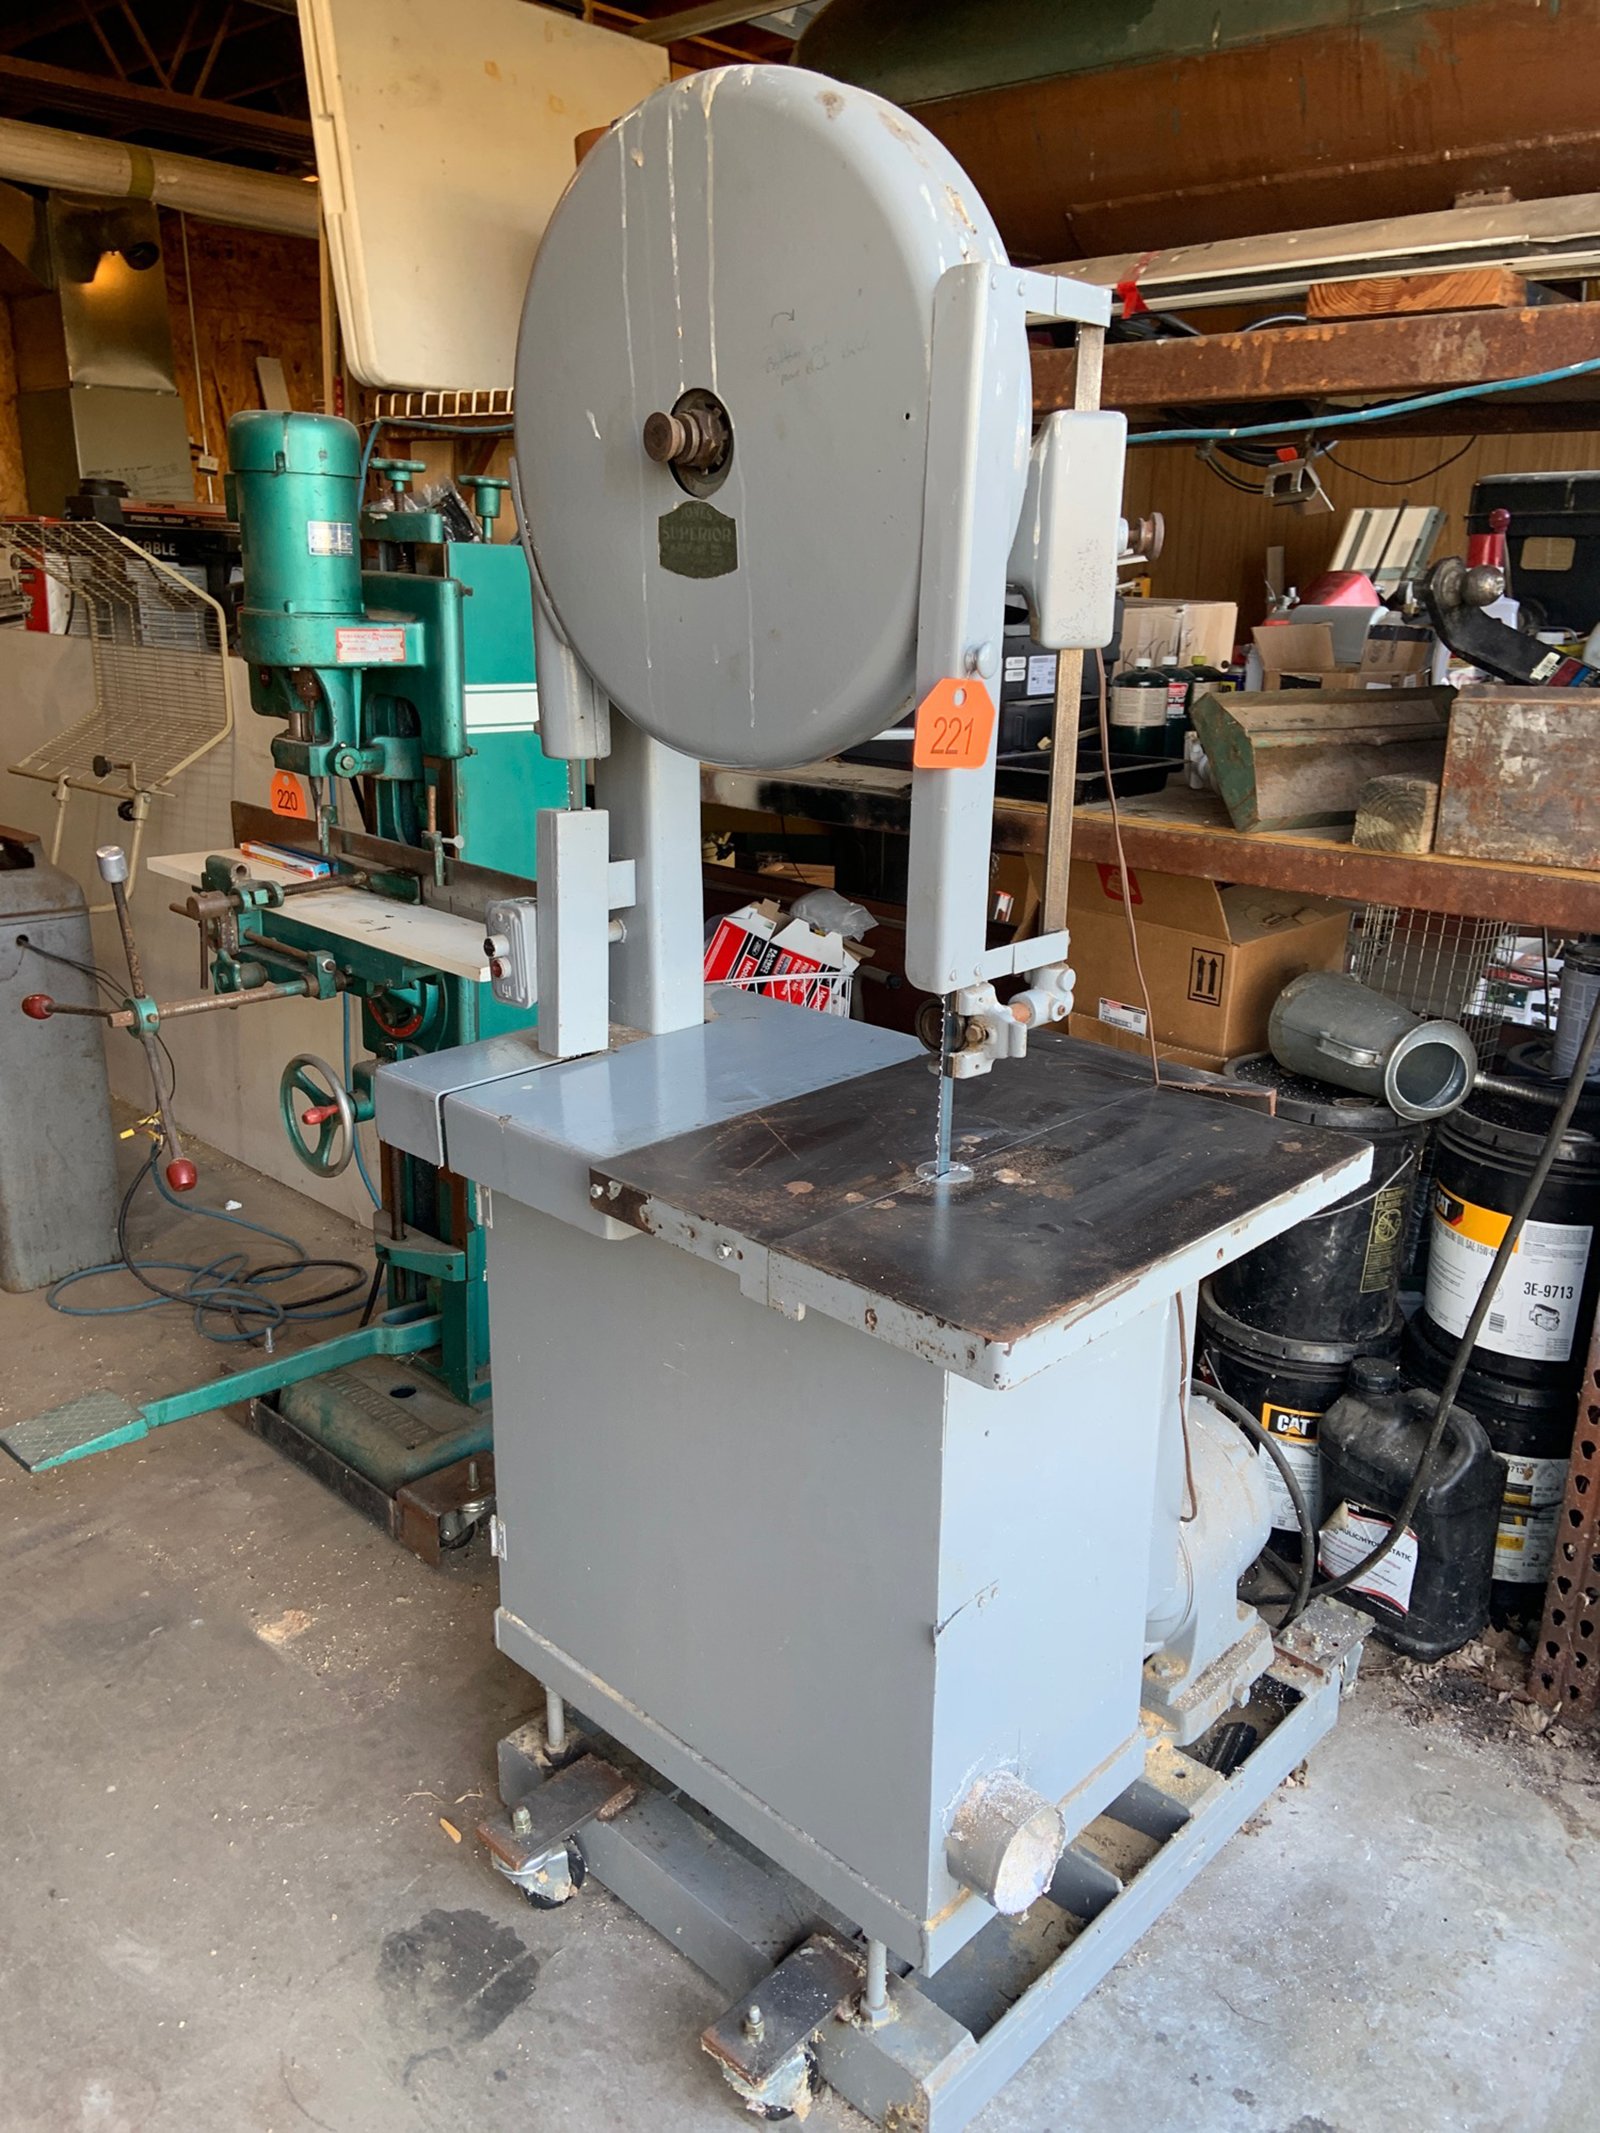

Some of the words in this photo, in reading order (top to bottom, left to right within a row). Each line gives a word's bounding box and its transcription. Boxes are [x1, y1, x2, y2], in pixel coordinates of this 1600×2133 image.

[662, 525, 732, 543] SUPERIOR
[930, 716, 975, 755] 221
[277, 788, 298, 811] 220
[1523, 1281, 1574, 1300] 3E-9713
[1277, 1414, 1311, 1436] CAT
